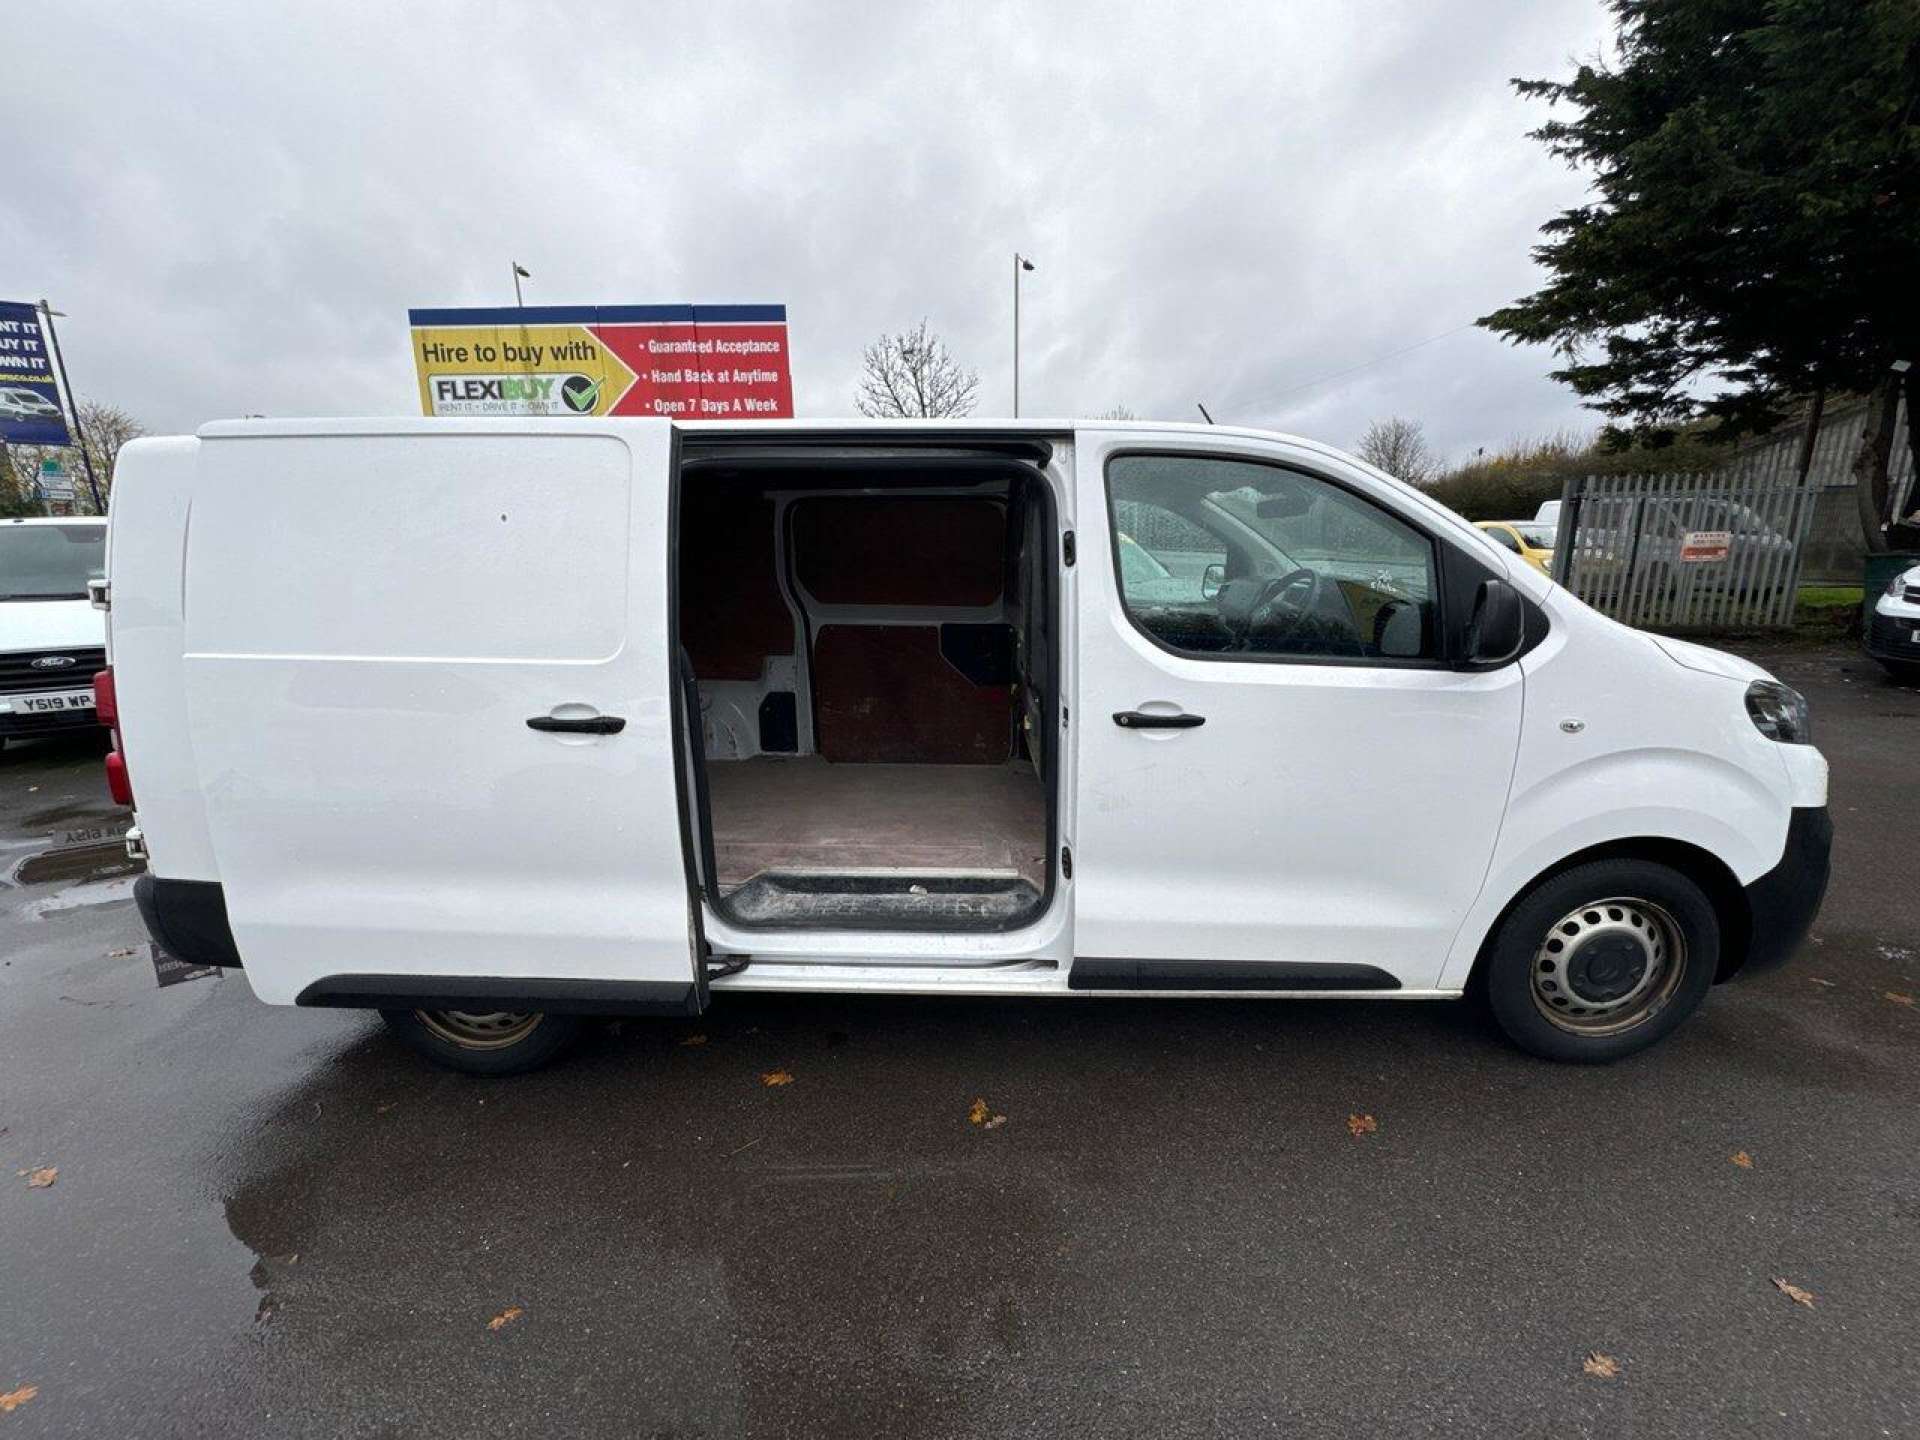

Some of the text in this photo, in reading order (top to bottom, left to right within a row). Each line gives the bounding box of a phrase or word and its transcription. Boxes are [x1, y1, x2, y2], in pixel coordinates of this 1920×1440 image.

[23, 322, 38, 334] IT
[23, 339, 38, 351] IT
[648, 339, 780, 355] Guaranteed Acceptance
[422, 341, 597, 366] Hire to buy with
[0, 356, 45, 369] WN IT
[651, 368, 778, 385] Hand Back at Anytime
[437, 376, 555, 401] FLEXIBUY
[465, 402, 473, 410] IT
[552, 401, 559, 409] IT
[654, 398, 778, 414] Open 7 Days A Week
[24, 695, 96, 711] YS19 WP
